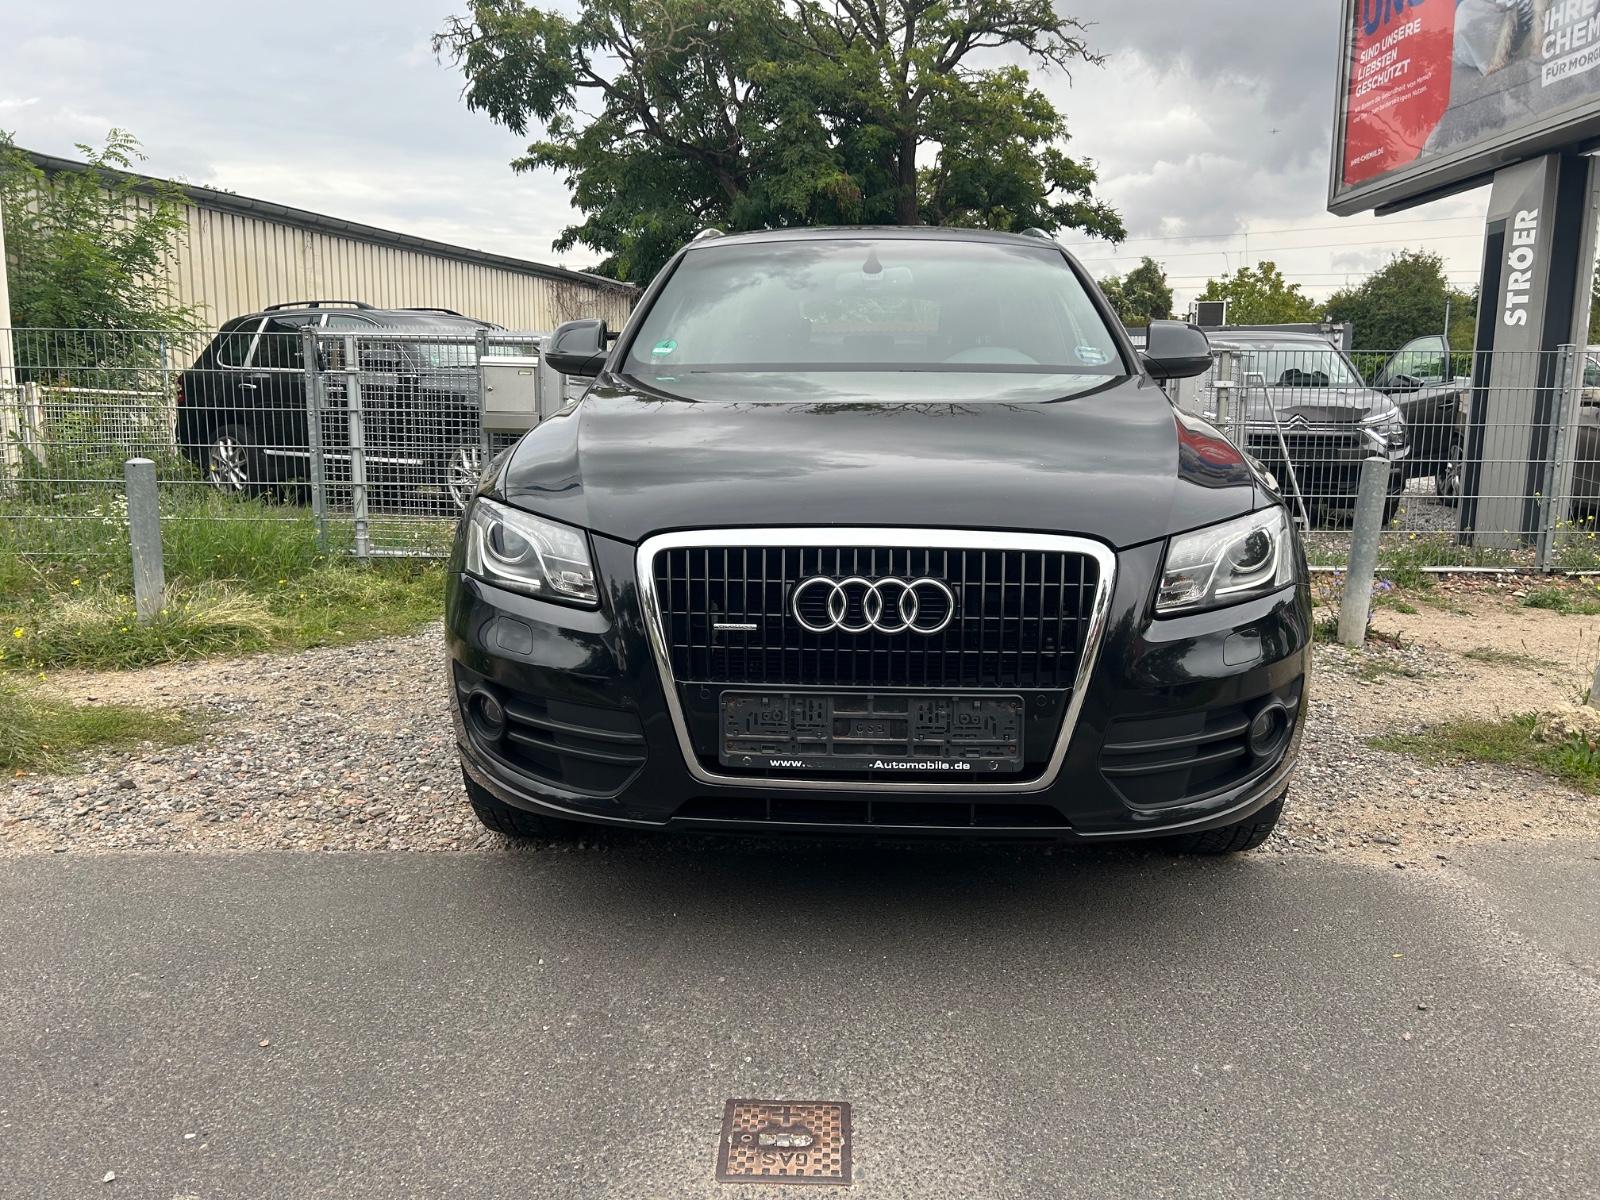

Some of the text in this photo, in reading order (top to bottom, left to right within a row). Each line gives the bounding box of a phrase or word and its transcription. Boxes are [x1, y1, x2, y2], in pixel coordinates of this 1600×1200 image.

[1543, 0, 1594, 34] IHRE
[1360, 18, 1421, 64] SIND UNSERE
[1355, 58, 1411, 97] GESCHÜTZT
[1357, 47, 1398, 81] LIEBSTEN
[1545, 47, 1600, 80] FÜR MORG
[1503, 208, 1538, 326] STRÖER
[769, 759, 806, 767] www.
[762, 1152, 808, 1167] GAS
